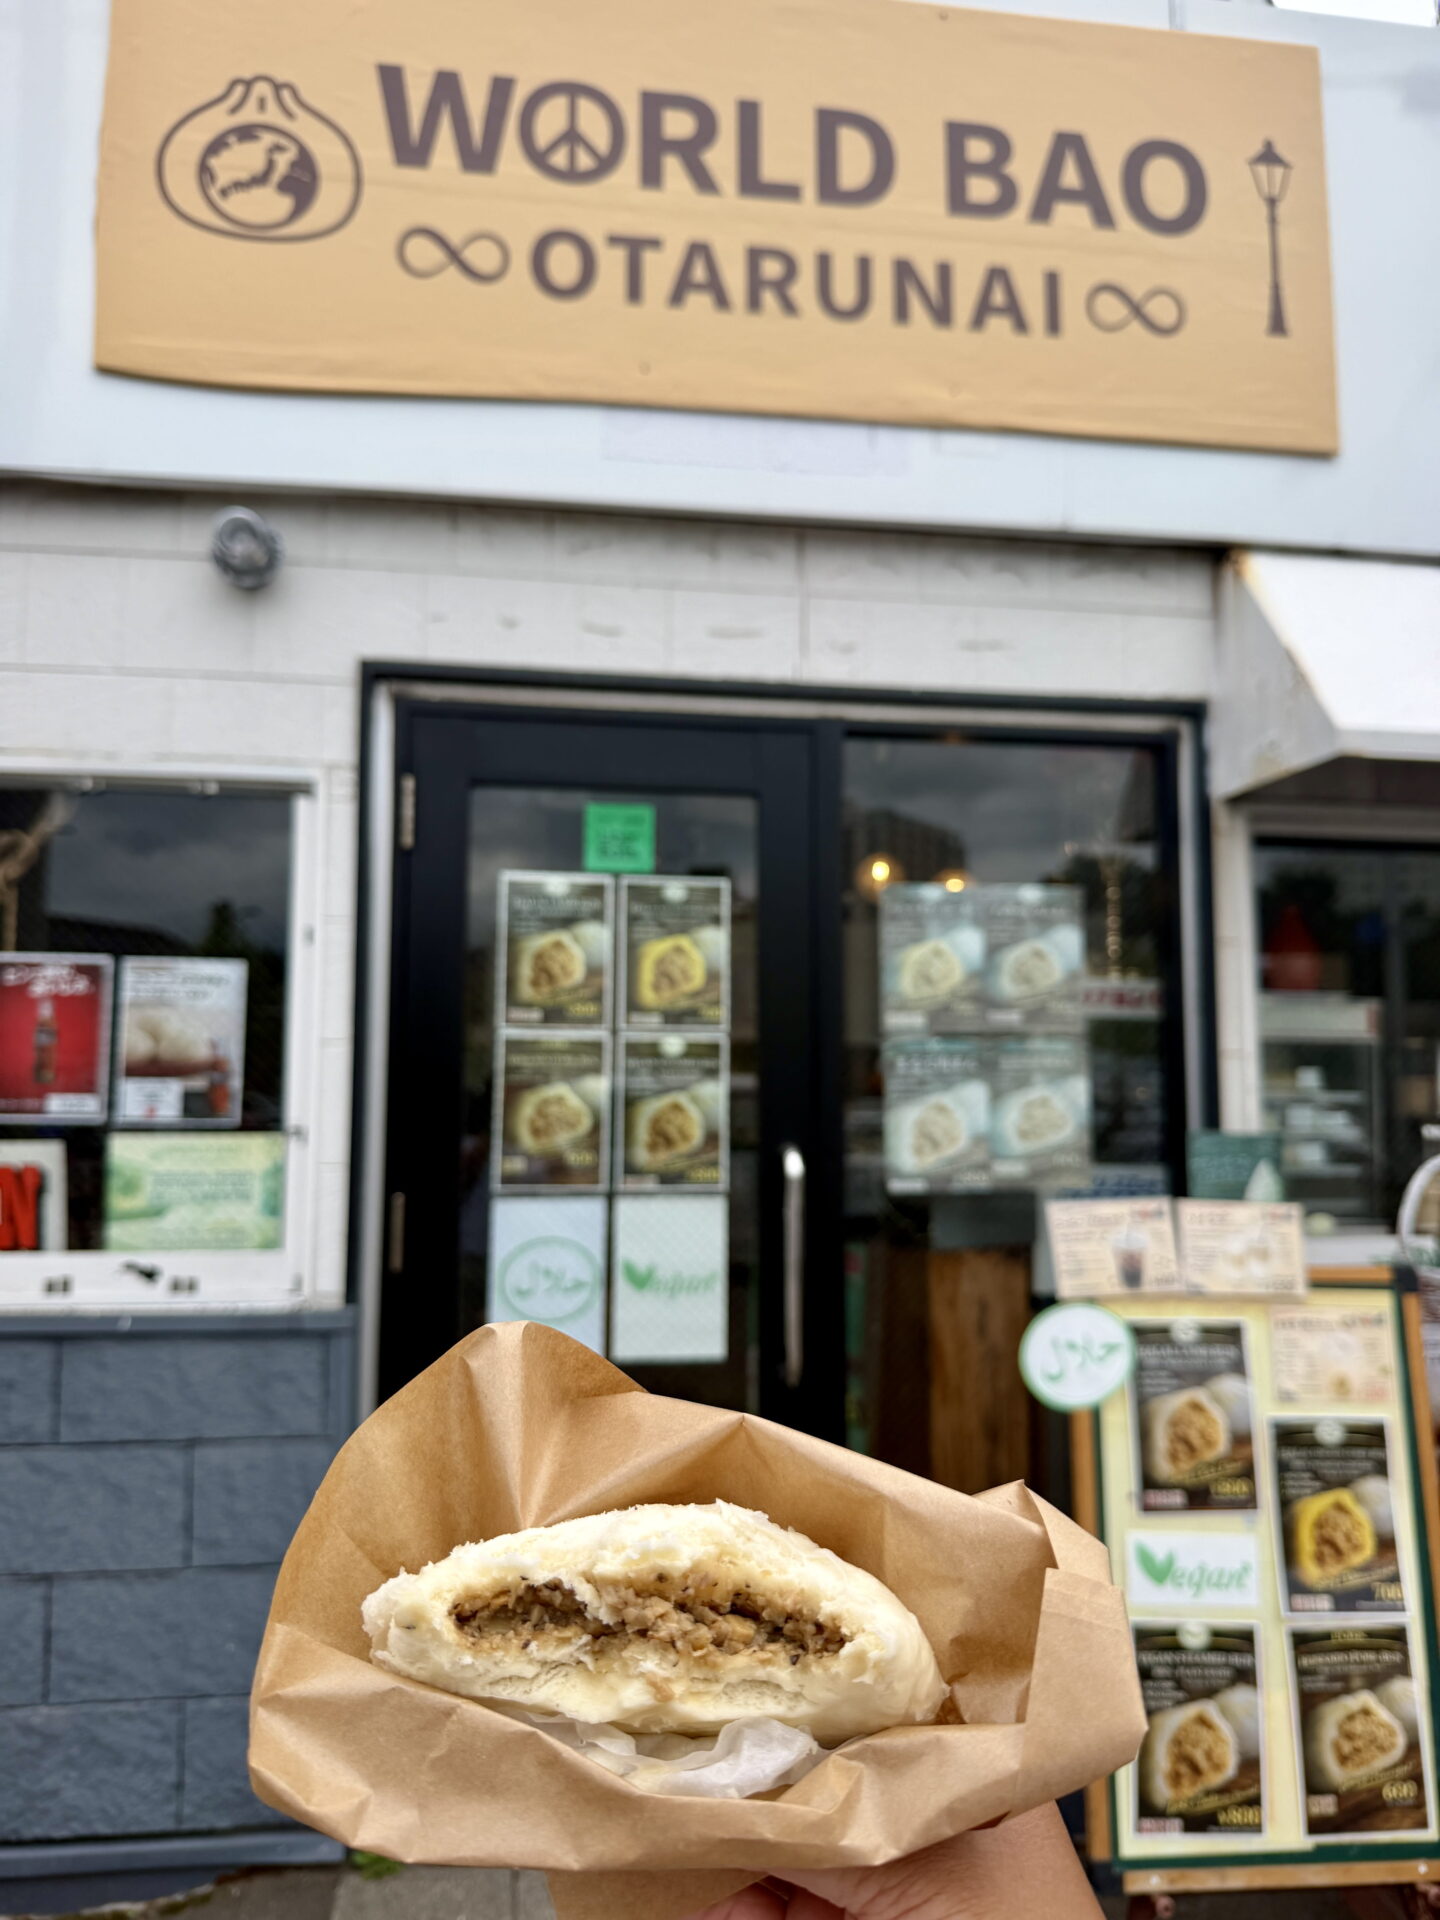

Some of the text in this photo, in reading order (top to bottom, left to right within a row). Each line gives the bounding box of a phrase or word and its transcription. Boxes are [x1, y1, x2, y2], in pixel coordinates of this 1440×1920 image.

[376, 62, 1209, 238] WORLD BAO
[529, 228, 1061, 338] OTARUNAI
[1133, 1539, 1253, 1599] Vegan
